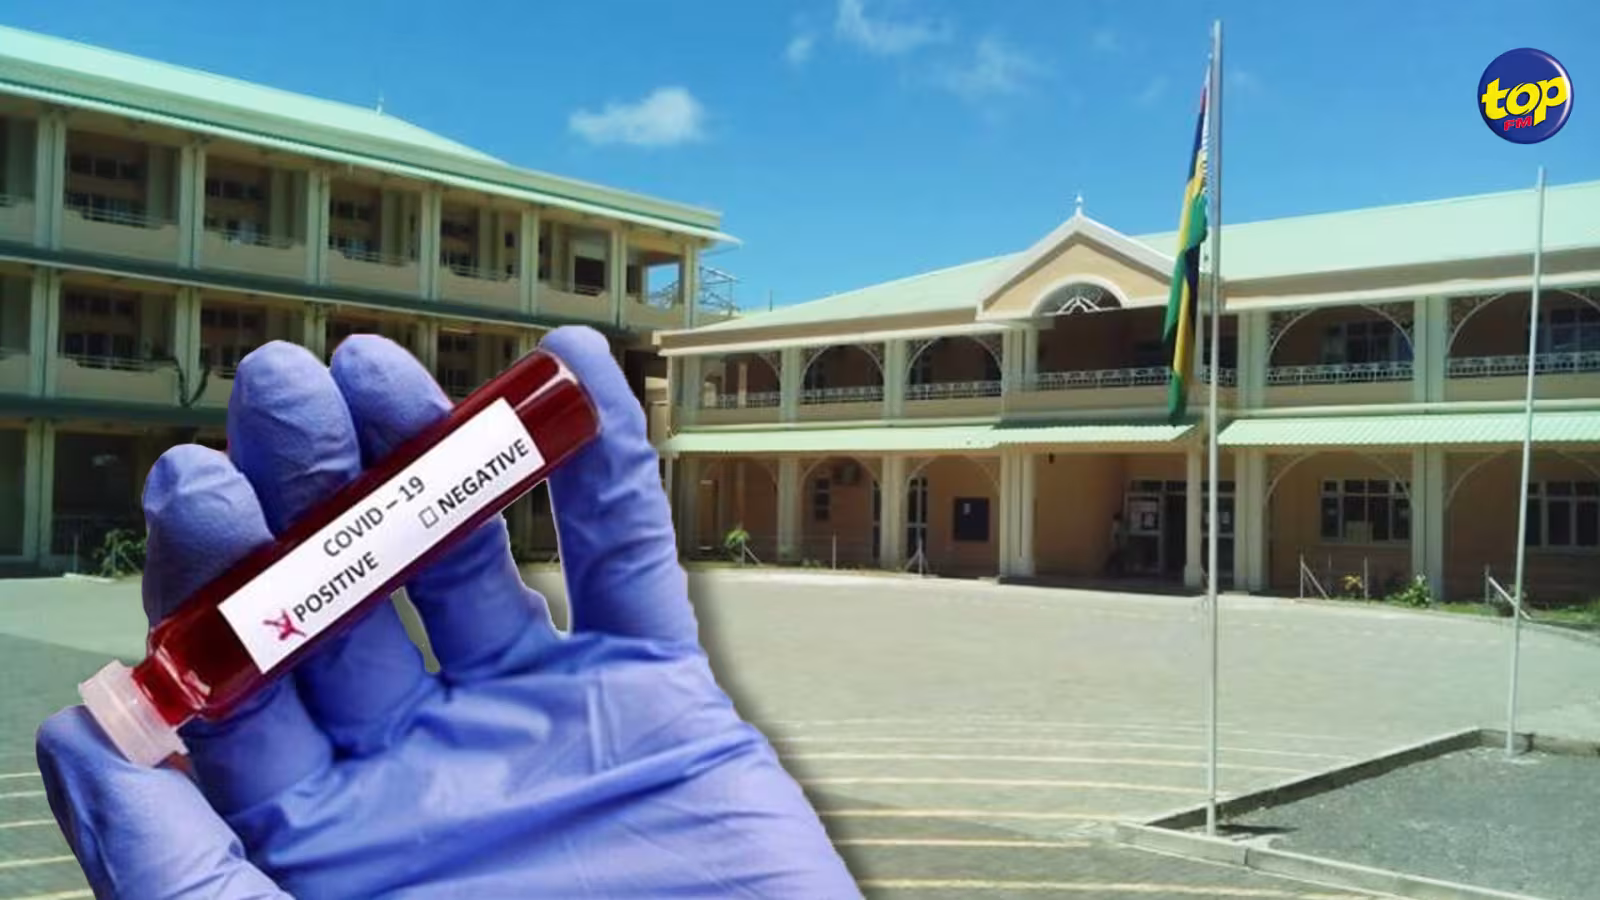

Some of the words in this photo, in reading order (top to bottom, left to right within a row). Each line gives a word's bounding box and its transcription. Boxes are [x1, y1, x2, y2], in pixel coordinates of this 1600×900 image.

[437, 438, 530, 515] NEGATIVE
[323, 506, 384, 557] COVID
[399, 476, 425, 503] 19
[293, 551, 379, 622] POSITIVE
